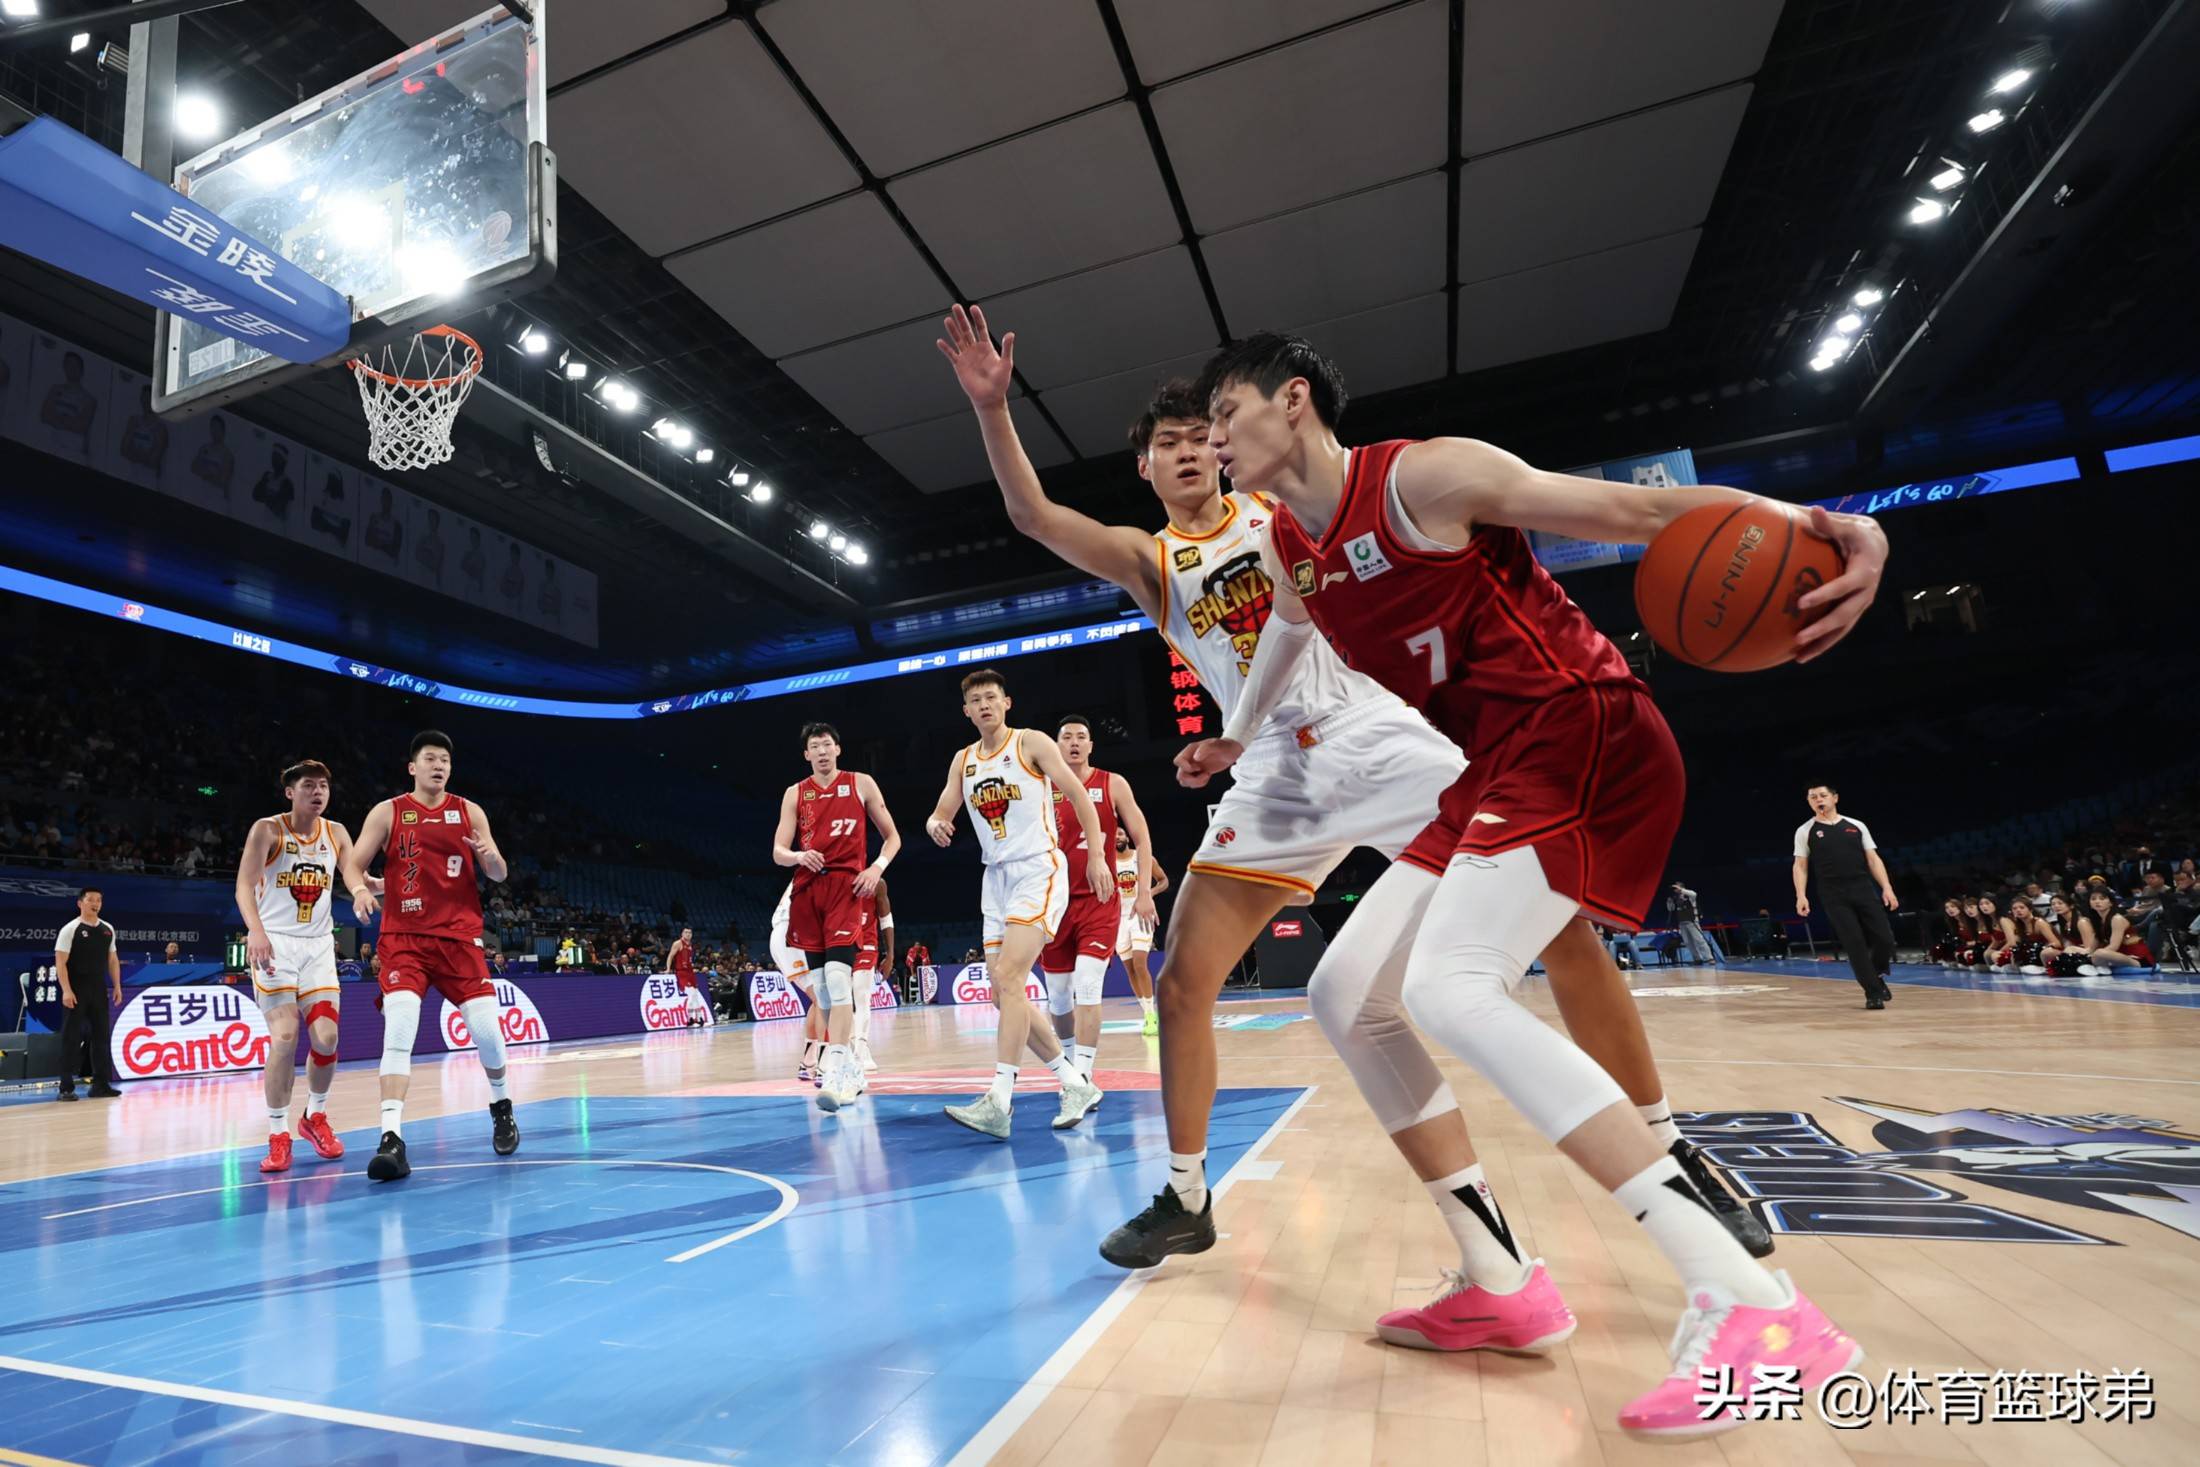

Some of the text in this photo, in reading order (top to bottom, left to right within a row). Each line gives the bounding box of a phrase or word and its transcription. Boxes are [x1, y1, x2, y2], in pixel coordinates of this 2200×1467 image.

[131, 206, 297, 305] 金陵
[1927, 484, 1953, 501] GO
[1704, 525, 1765, 629] LI-NING
[1405, 626, 1448, 685] 7
[830, 818, 857, 837] 27
[991, 816, 1007, 840] 9
[447, 855, 463, 877] 9
[297, 902, 312, 923] 8
[755, 975, 786, 993] 百岁山
[142, 992, 241, 1026] 百岁山
